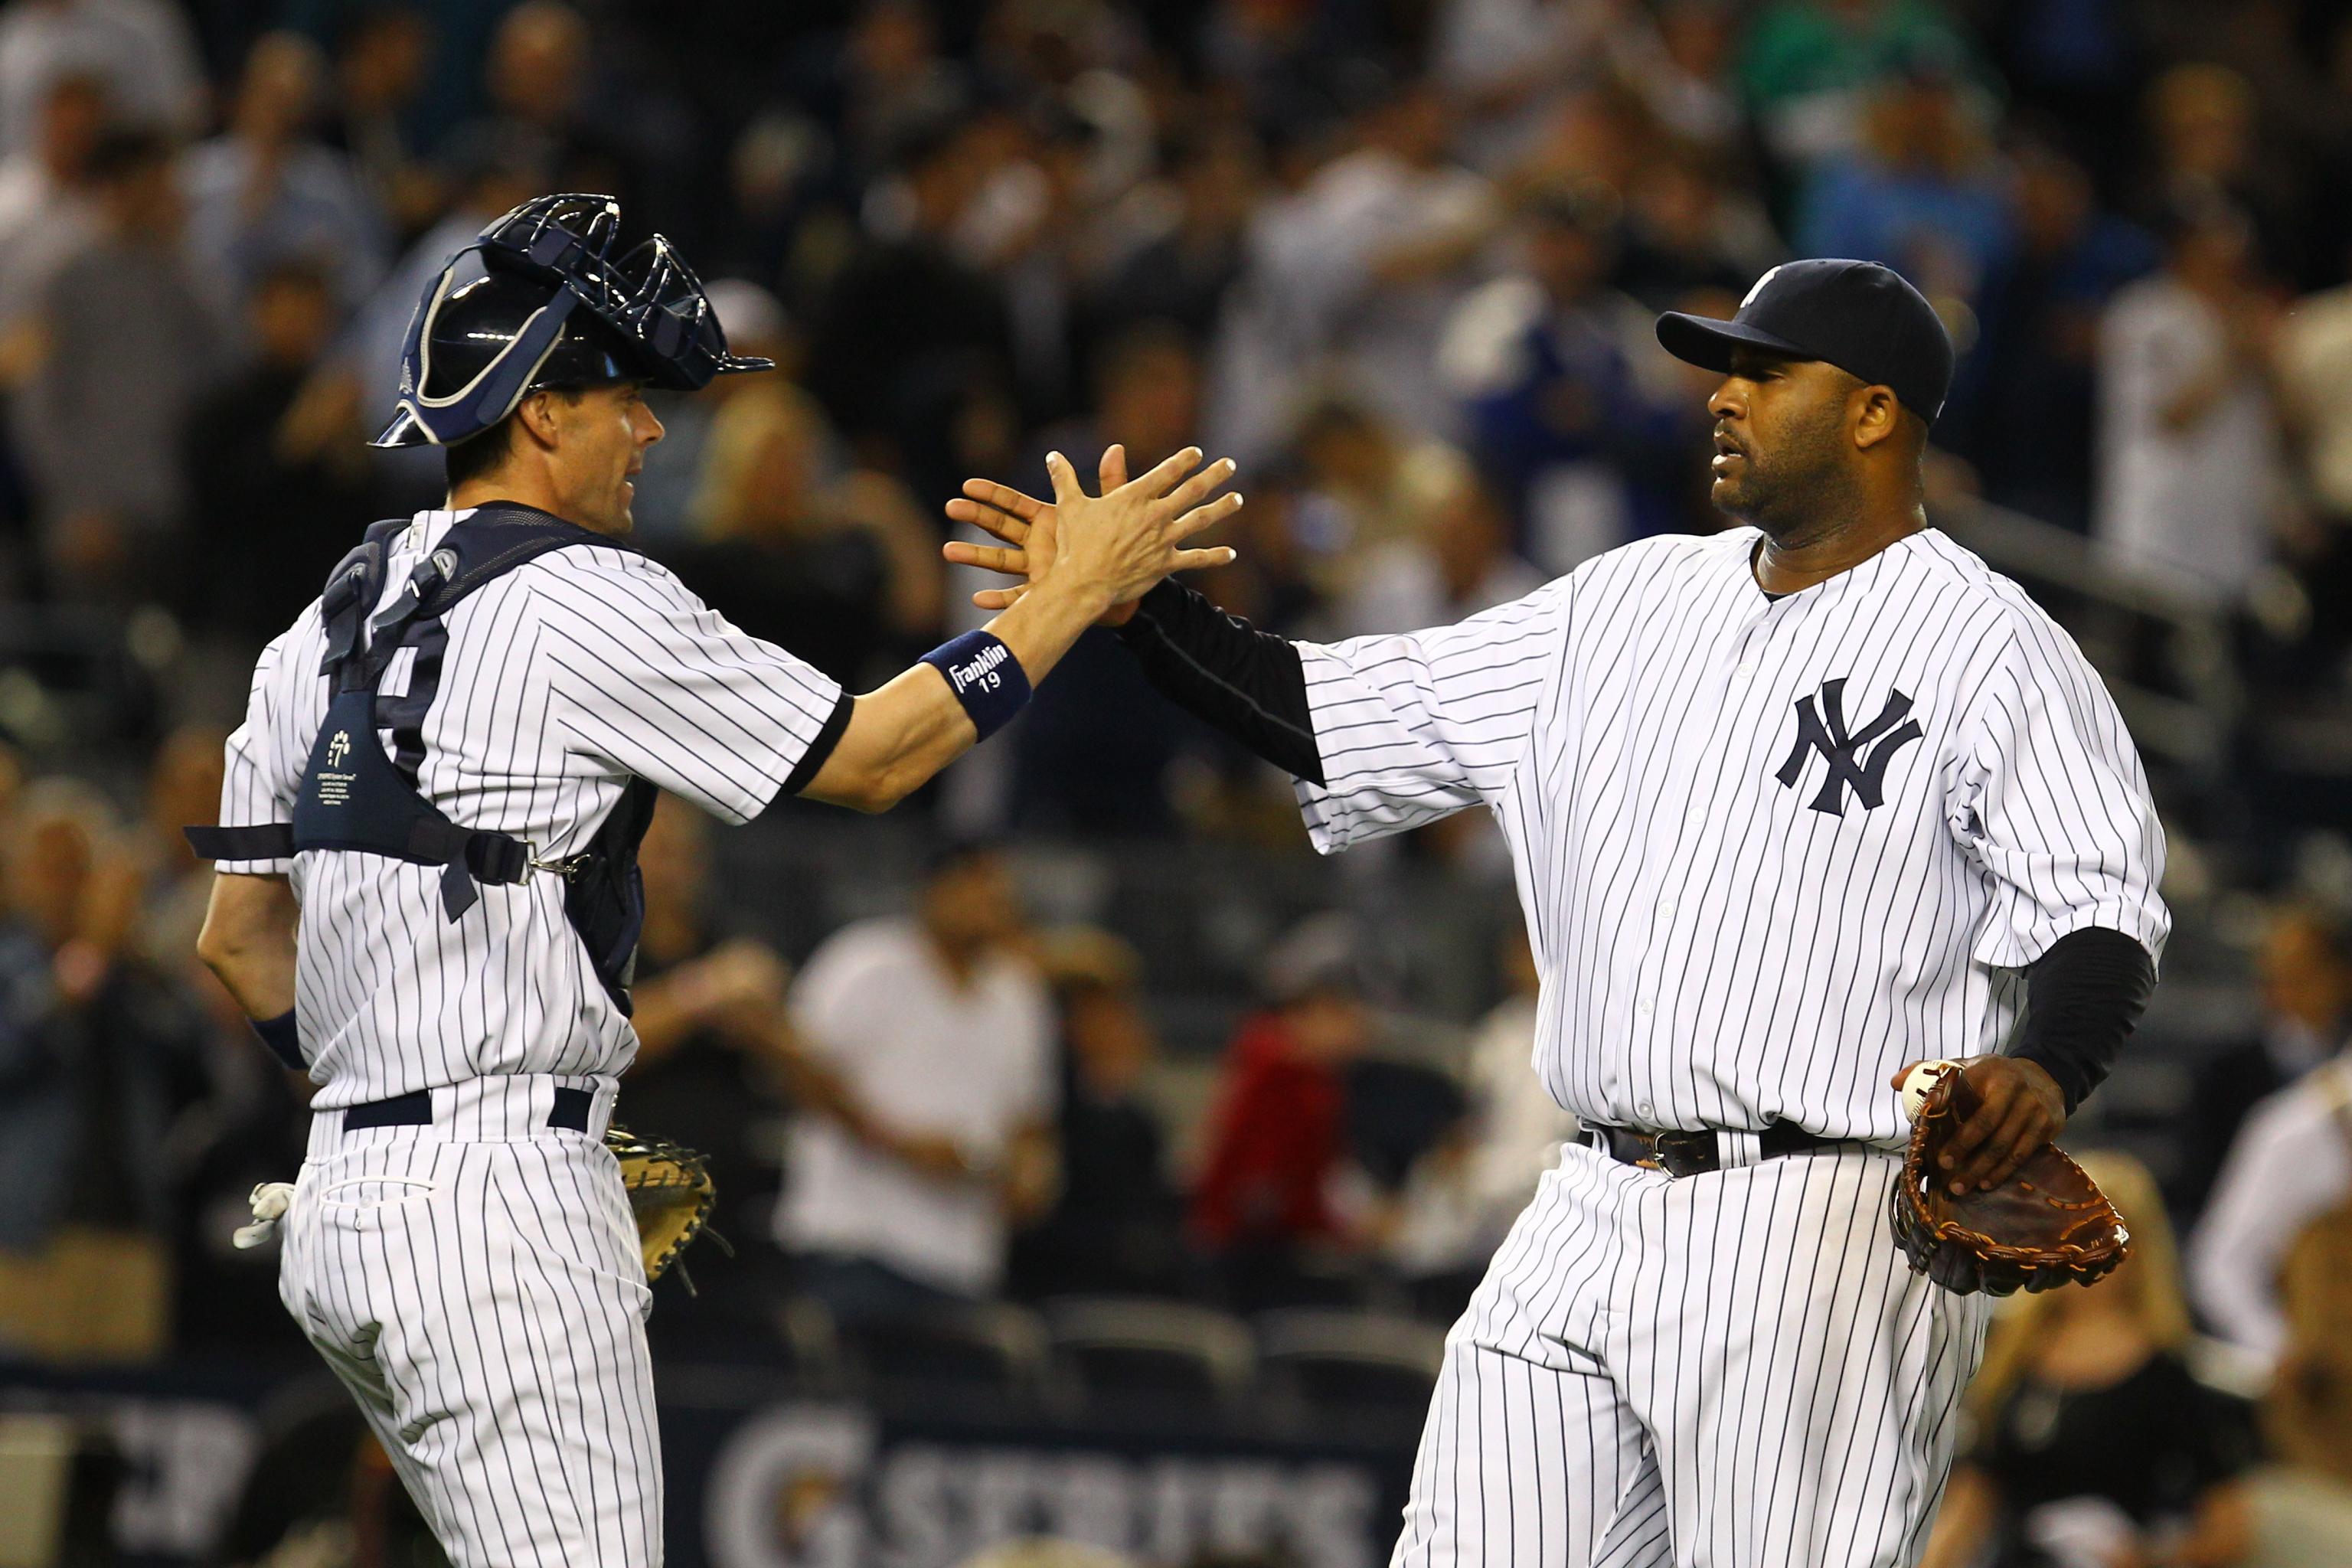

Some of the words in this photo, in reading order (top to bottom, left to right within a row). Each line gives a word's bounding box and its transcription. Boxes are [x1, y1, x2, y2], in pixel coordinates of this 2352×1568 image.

[949, 645, 1008, 694] Franklin
[978, 671, 1001, 693] 19
[1775, 678, 1923, 818] NY
